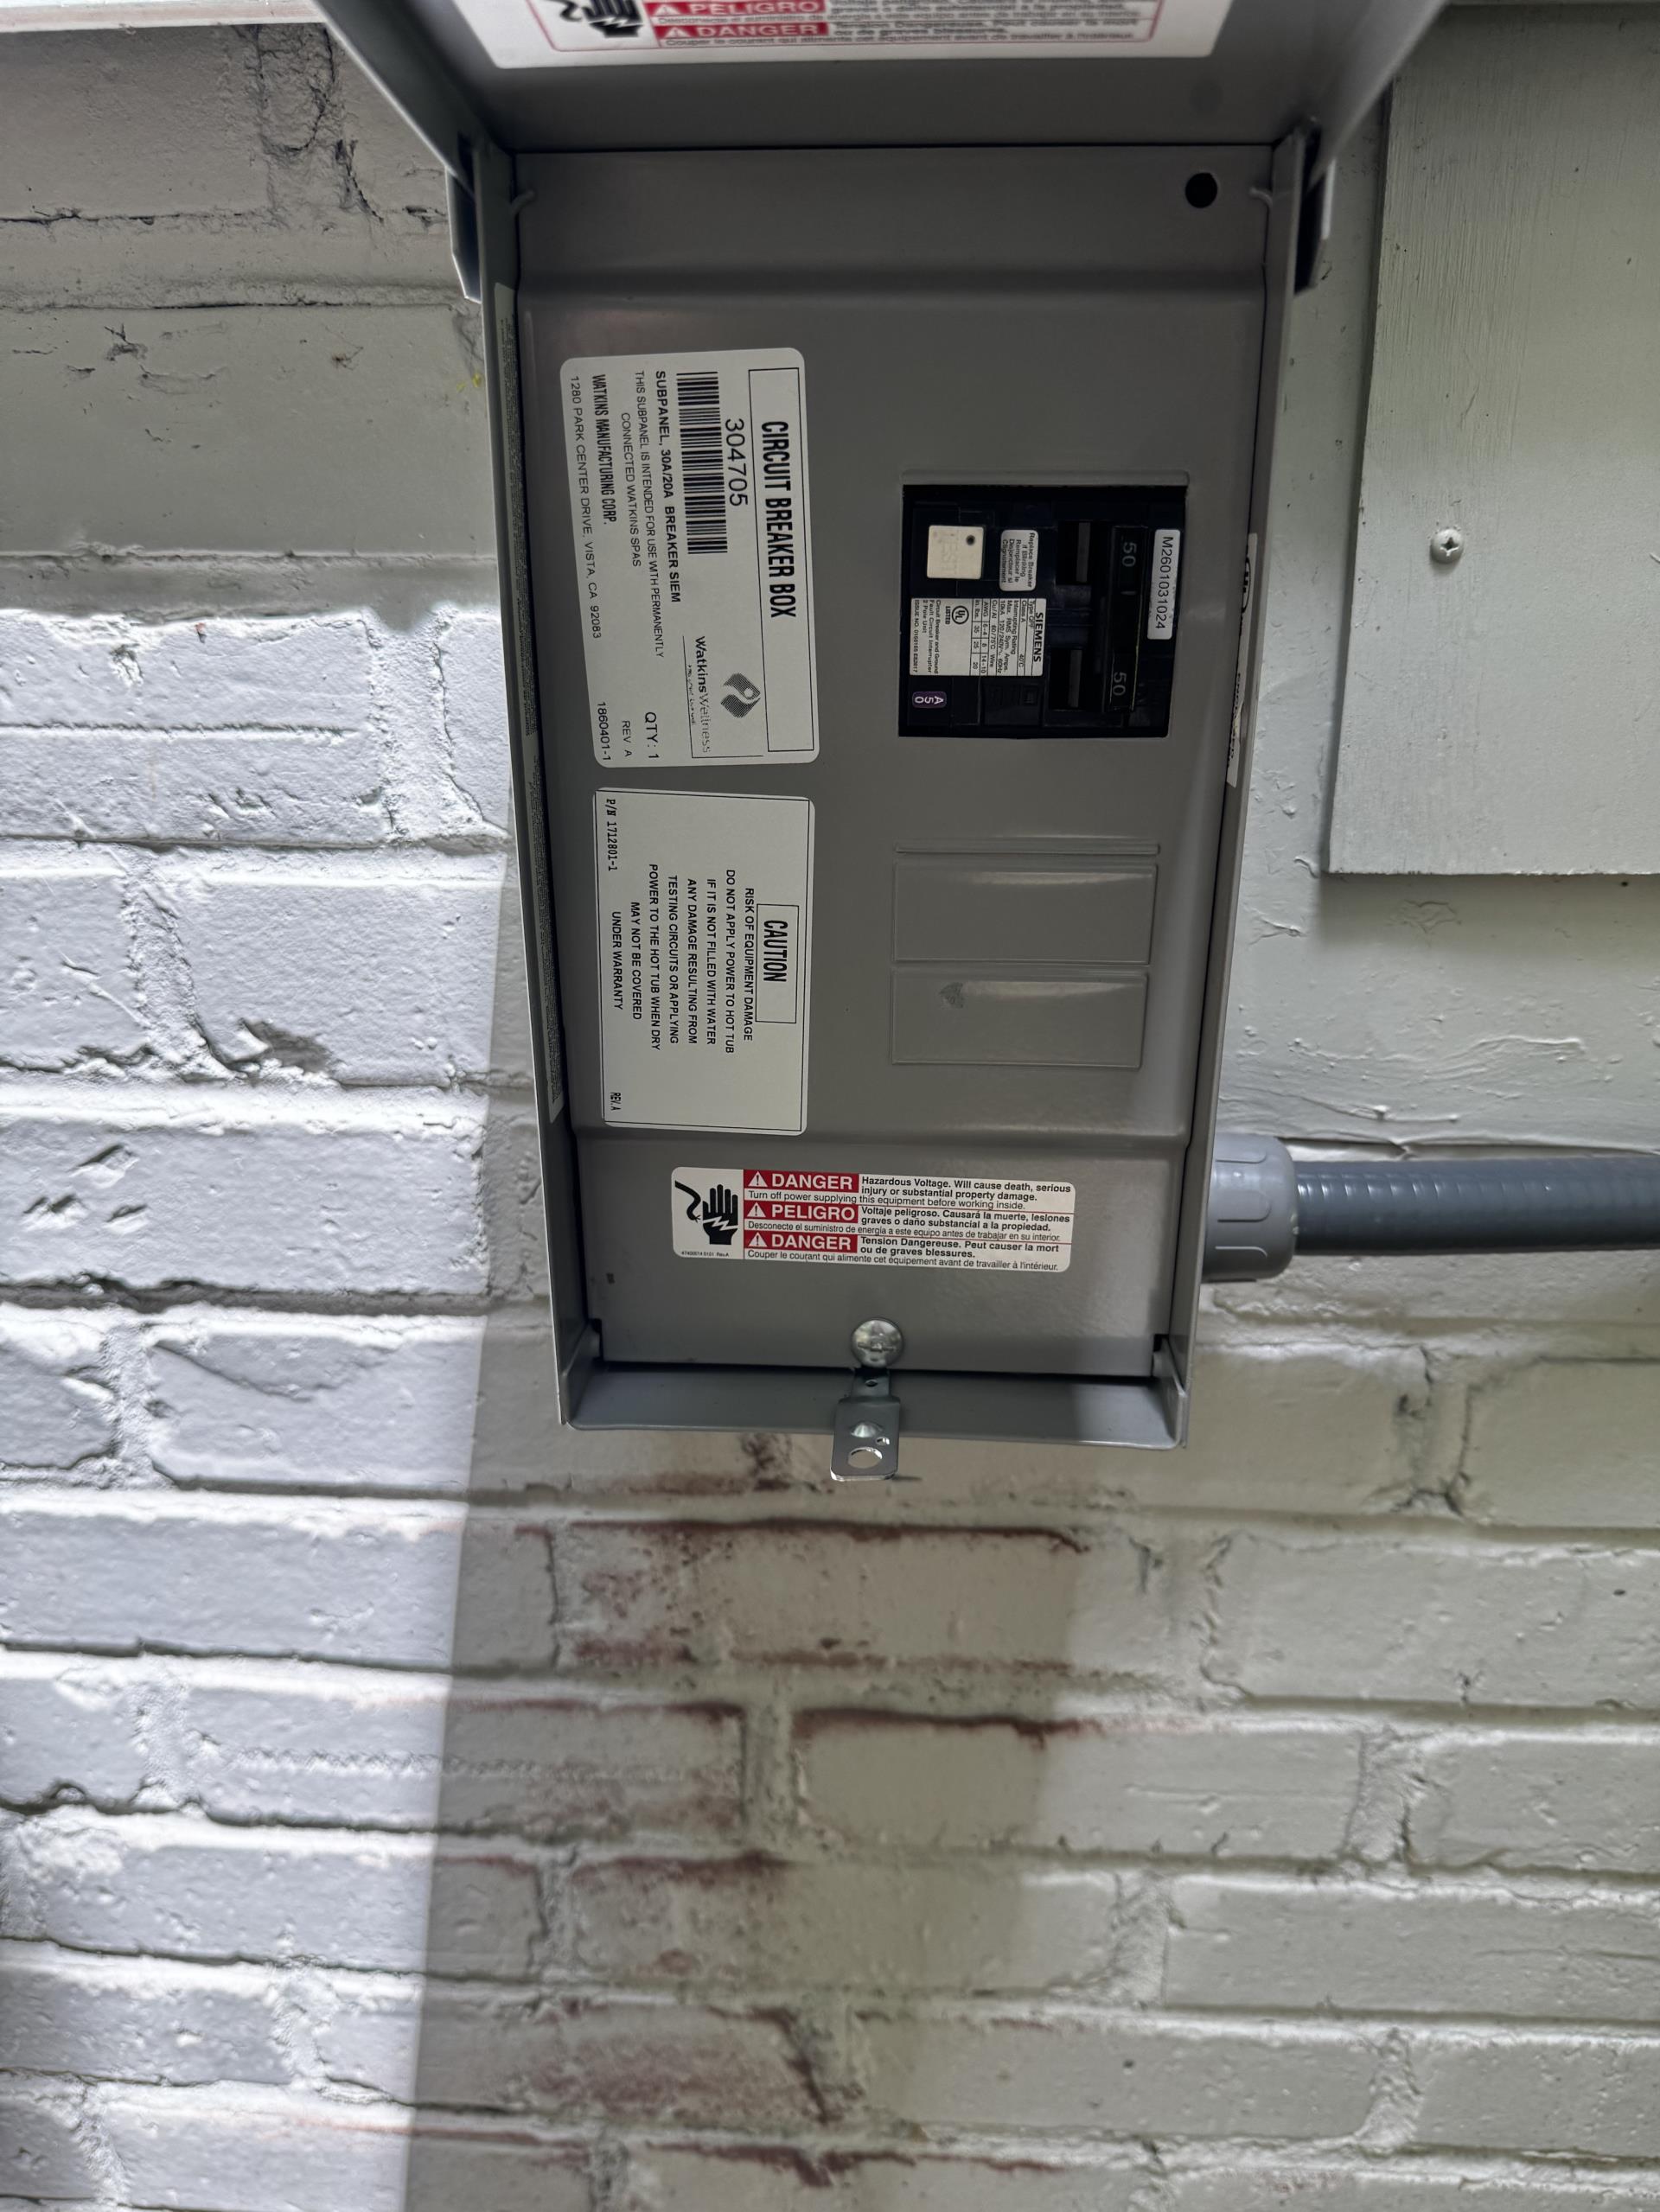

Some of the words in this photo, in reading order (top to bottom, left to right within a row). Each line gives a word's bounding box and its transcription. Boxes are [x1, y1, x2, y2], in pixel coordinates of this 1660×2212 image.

[696, 24, 819, 36] DANGER
[570, 375, 583, 403] 1280
[592, 374, 609, 415] WATKINS
[635, 370, 646, 393] THIS
[654, 370, 671, 445] SUBPANEL,
[572, 407, 585, 440] PARK
[636, 396, 650, 448] SUBPANEL
[596, 418, 615, 494] MANUFACTURING
[621, 412, 635, 481] CONNECTED
[641, 451, 651, 460] IS
[761, 420, 792, 490] CIRCUIT
[576, 444, 590, 494] CENTER
[660, 449, 674, 498] 30A/20A
[725, 418, 748, 507] 304705
[641, 463, 654, 513] INTENDED
[579, 498, 593, 537] DRIVE,
[601, 498, 616, 526] CORP.
[626, 484, 639, 534] WATKINS
[645, 515, 656, 535] FOR
[664, 506, 680, 568] BREAKER
[764, 498, 795, 577] BREAKER
[583, 541, 597, 577] VISTA,
[629, 538, 642, 568] SPAS
[646, 539, 658, 558] USE
[1121, 542, 1136, 567] 50
[648, 560, 660, 585] WITH
[1155, 536, 1173, 629] M2601031024
[586, 582, 598, 598] CA
[668, 571, 682, 603] SIEM
[769, 583, 796, 619] BOX
[588, 605, 602, 640] 92083
[649, 588, 665, 659] PERMANENTLY
[1033, 613, 1044, 662] SIEMENS
[1112, 672, 1127, 696] 50
[597, 701, 610, 762] 1860401-1
[622, 720, 632, 743] REV
[643, 711, 659, 746] QTY:
[605, 799, 617, 816] P/N
[606, 821, 618, 871] 1712801-1
[648, 864, 659, 904] POWER
[687, 878, 697, 901] ANY
[707, 878, 716, 888] IF
[726, 869, 735, 884] DO
[668, 875, 678, 920] TESTING
[707, 891, 716, 900] IT
[707, 903, 716, 913] IS
[726, 889, 735, 910] NOT
[744, 888, 754, 913] RISK
[630, 902, 641, 924] MAY
[649, 908, 659, 921] TO
[687, 904, 697, 950] DAMAGE
[707, 916, 716, 938] NOT
[744, 915, 754, 930] OF
[612, 911, 622, 947] UNDER
[631, 928, 641, 949] NOT
[649, 925, 660, 945] THE
[725, 913, 735, 948] APPLY
[631, 953, 641, 966] BE
[649, 948, 660, 970] HOT
[668, 923, 679, 971] CIRCUITS
[707, 941, 716, 977] FILLED
[763, 920, 789, 983] CAUTION
[725, 952, 734, 990] POWER
[744, 934, 754, 994] EQUIPMENT
[612, 951, 623, 1010] WARRANTY
[632, 969, 642, 1020] COVERED
[650, 973, 660, 992] TUB
[669, 974, 679, 989] OR
[687, 953, 697, 1010] RESULTING
[707, 979, 716, 1004] WITH
[650, 997, 661, 1026] WHEN
[725, 993, 734, 1006] TO
[669, 992, 679, 1044] APPLYING
[688, 1015, 697, 1044] FROM
[707, 1008, 716, 1045] WATER
[725, 1010, 734, 1030] HOT
[744, 998, 753, 1042] DAMAGE
[650, 1030, 661, 1051] DRY
[725, 1034, 734, 1054] TUB
[610, 1092, 621, 1104] REV.
[772, 1174, 852, 1189] DANGER
[862, 1176, 910, 1186] Hazardous
[915, 1179, 951, 1189] Voltage.
[1005, 1182, 1033, 1192] death,
[862, 1187, 887, 1195] injury
[903, 1189, 952, 1197] substantial
[955, 1191, 994, 1201] property
[998, 1192, 1038, 1202] damage.
[749, 1190, 768, 1199] Turn
[814, 1195, 857, 1204] supplying
[878, 1197, 924, 1206] equipment
[959, 1201, 993, 1210] working
[996, 1201, 1025, 1209] inside.
[772, 1204, 855, 1221] PELIGRO
[862, 1207, 891, 1216] Voltaje
[895, 1208, 940, 1218] peligroso.
[943, 1210, 980, 1219] Causará
[984, 1211, 991, 1220] la
[994, 1213, 1028, 1221] muerte,
[1031, 1214, 1070, 1222] lesiones
[903, 1217, 925, 1226] daño
[929, 1220, 980, 1228] substancial
[1002, 1223, 1050, 1232] propiedad.
[772, 1234, 851, 1250] DANGER
[901, 1238, 961, 1248] Dangereuse.
[1025, 1243, 1033, 1252] la
[926, 1248, 975, 1258] blessures.
